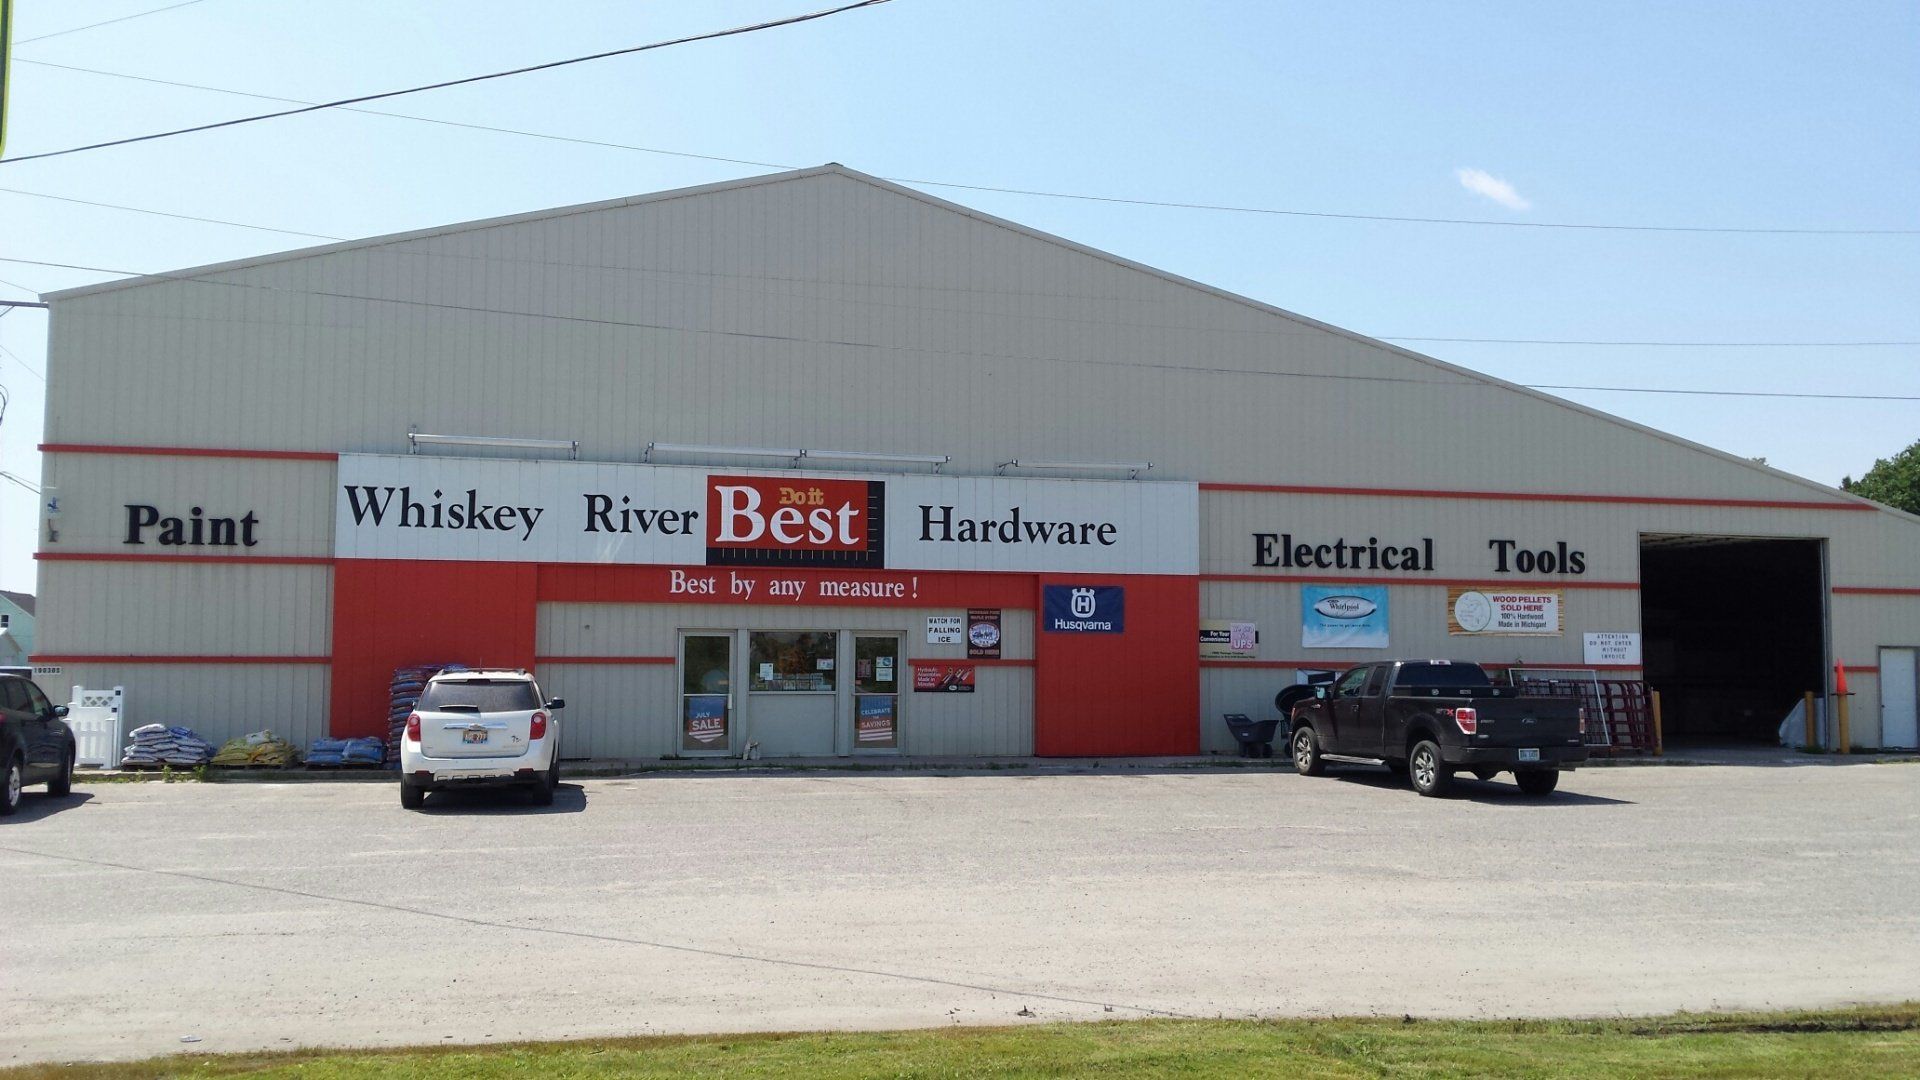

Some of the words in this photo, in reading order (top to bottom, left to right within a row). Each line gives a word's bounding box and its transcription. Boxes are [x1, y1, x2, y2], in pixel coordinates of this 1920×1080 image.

[779, 487, 806, 505] Do
[807, 488, 824, 506] it
[344, 485, 544, 541] Whiskey
[583, 494, 699, 535] River
[714, 485, 860, 544] Best
[123, 504, 259, 547] Paint
[918, 504, 1117, 545] Hardware
[1252, 533, 1435, 571] Electrical
[1489, 539, 1586, 574] Tools
[669, 569, 716, 595] Best
[730, 571, 755, 600] by
[769, 578, 806, 601] any
[819, 578, 905, 599] measure
[1329, 603, 1360, 611] Whirlpool
[1055, 618, 1112, 631] Husqvarna
[1234, 639, 1253, 649] UPS
[861, 708, 891, 716] CELEBRATE
[692, 718, 721, 731] SALE
[861, 720, 891, 729] SAVINGS
